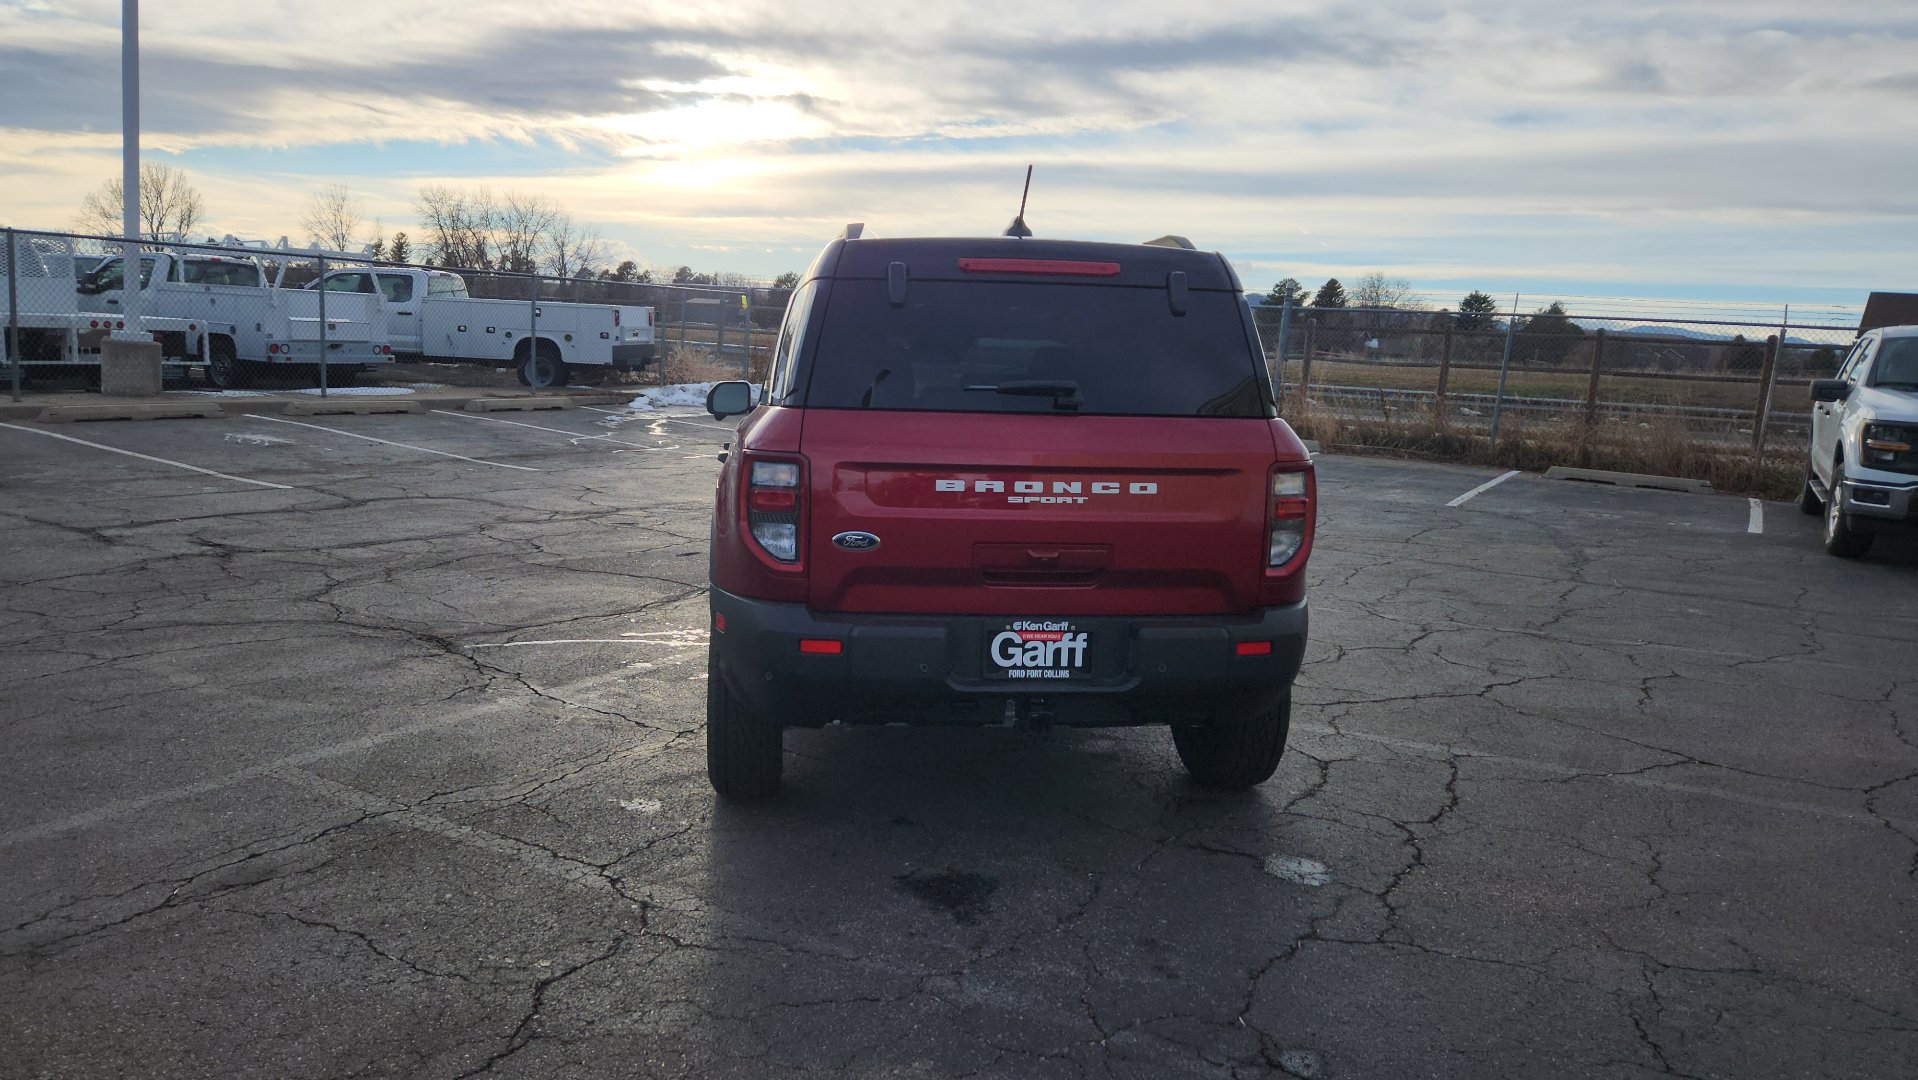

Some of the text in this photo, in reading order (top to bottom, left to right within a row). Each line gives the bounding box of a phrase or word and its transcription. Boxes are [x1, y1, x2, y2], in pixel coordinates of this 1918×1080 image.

[935, 479, 1158, 495] BRONCO
[1007, 496, 1088, 504] SPORT
[843, 535, 869, 547] Ford
[1022, 621, 1069, 631] Ken Garff
[991, 631, 1088, 668] Garff
[1008, 669, 1070, 678] FORD FORT COLLINS
